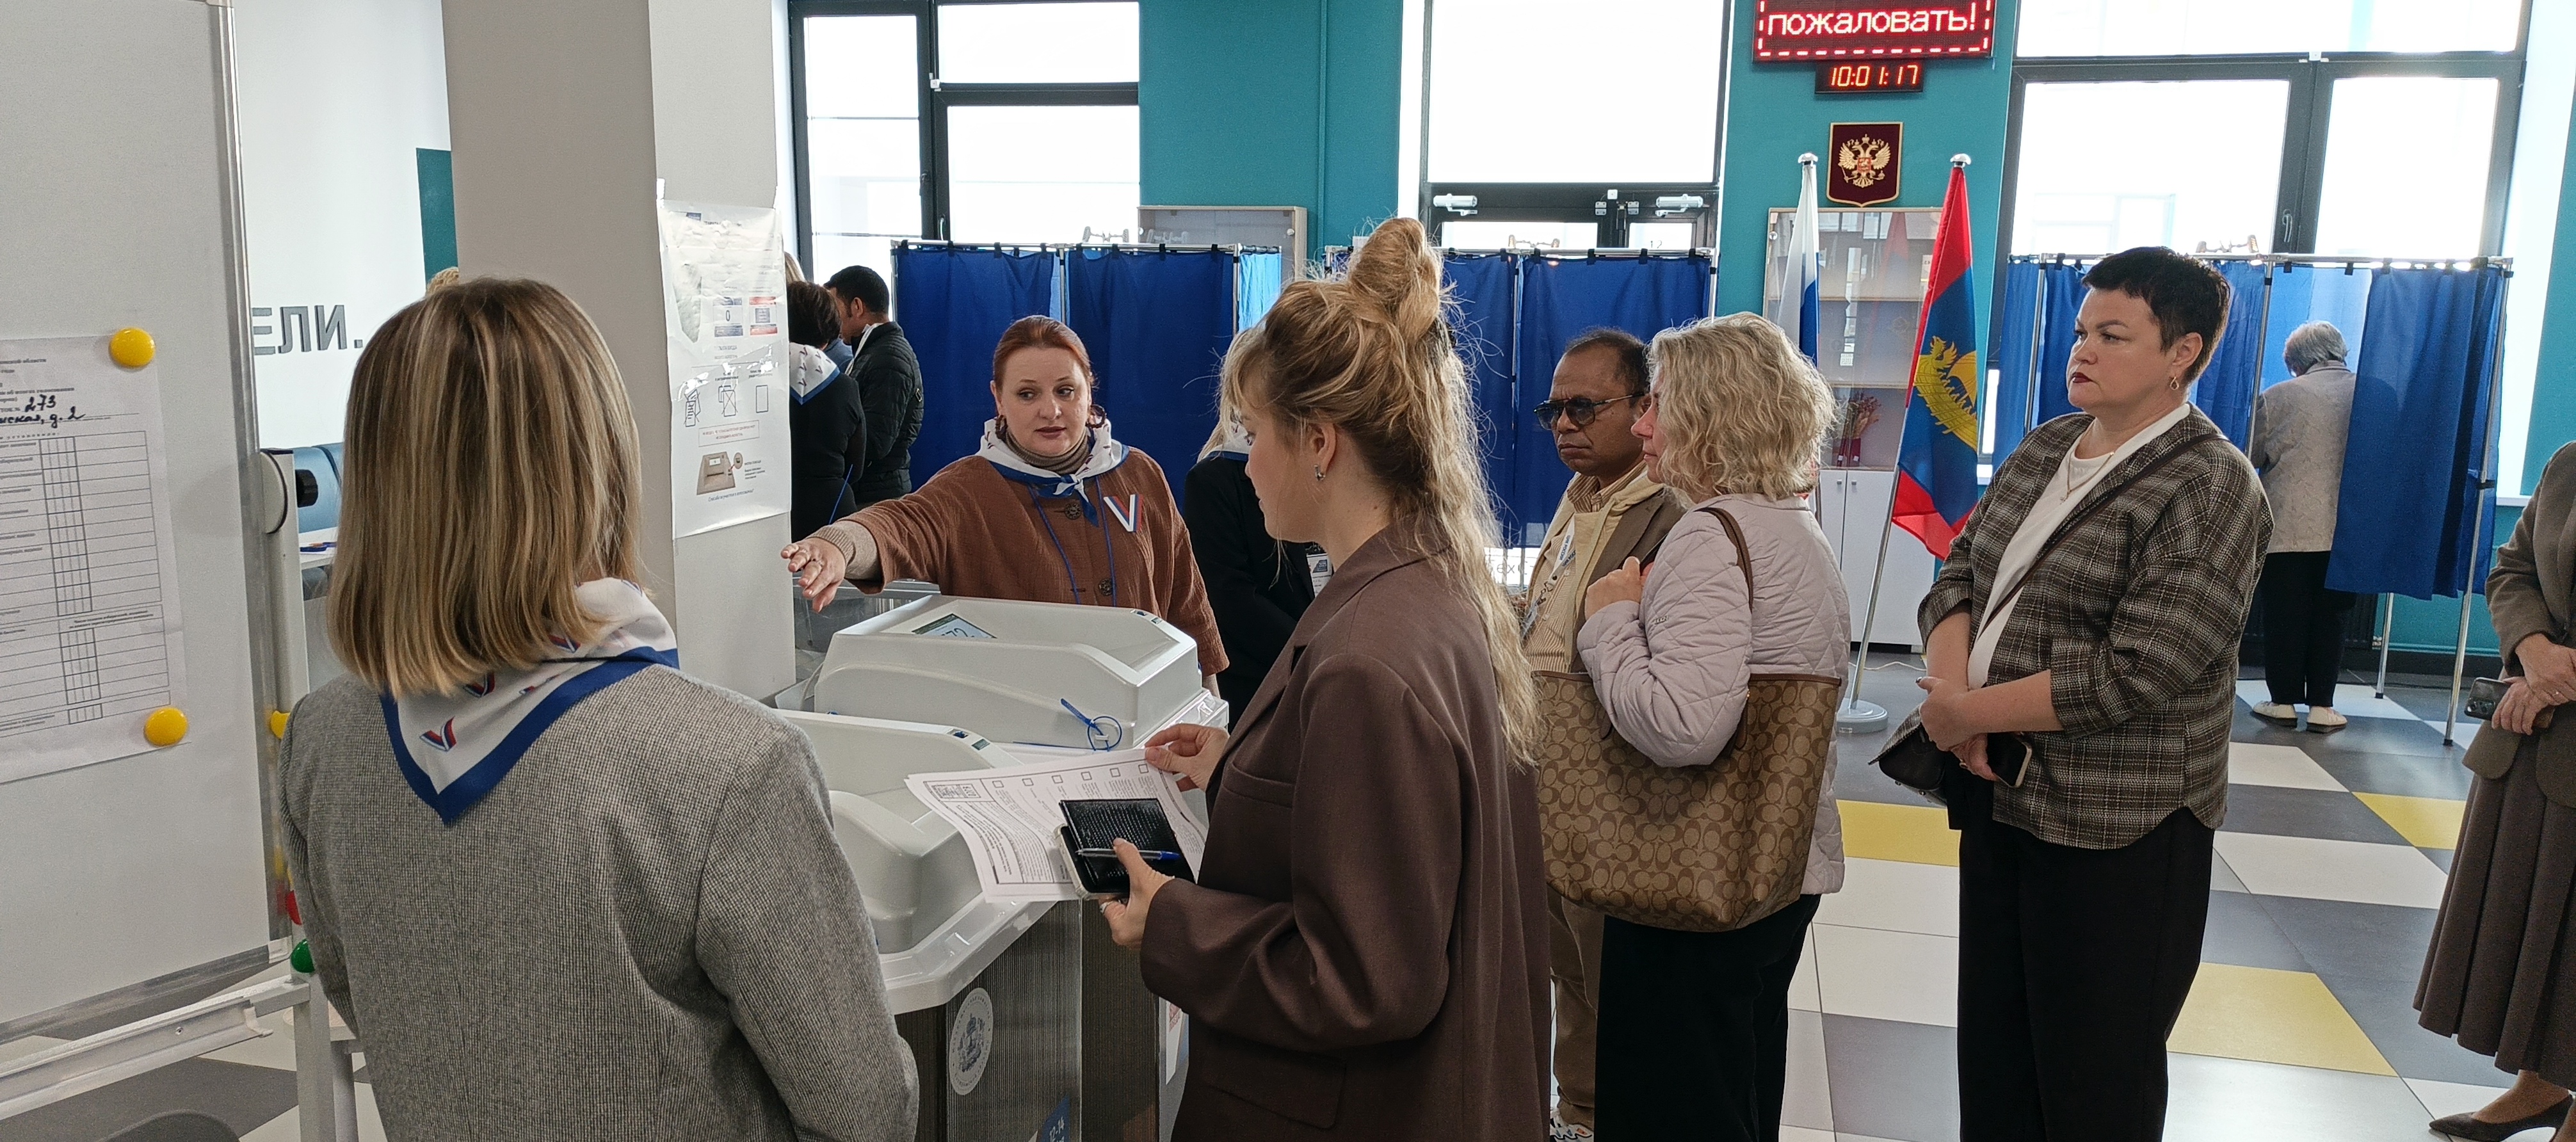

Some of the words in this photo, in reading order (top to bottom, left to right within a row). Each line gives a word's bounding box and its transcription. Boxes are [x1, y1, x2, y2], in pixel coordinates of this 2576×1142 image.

[1767, 2, 1976, 35] пожаловать!
[1831, 65, 1919, 87] 10:01:17
[24, 394, 56, 412] 273
